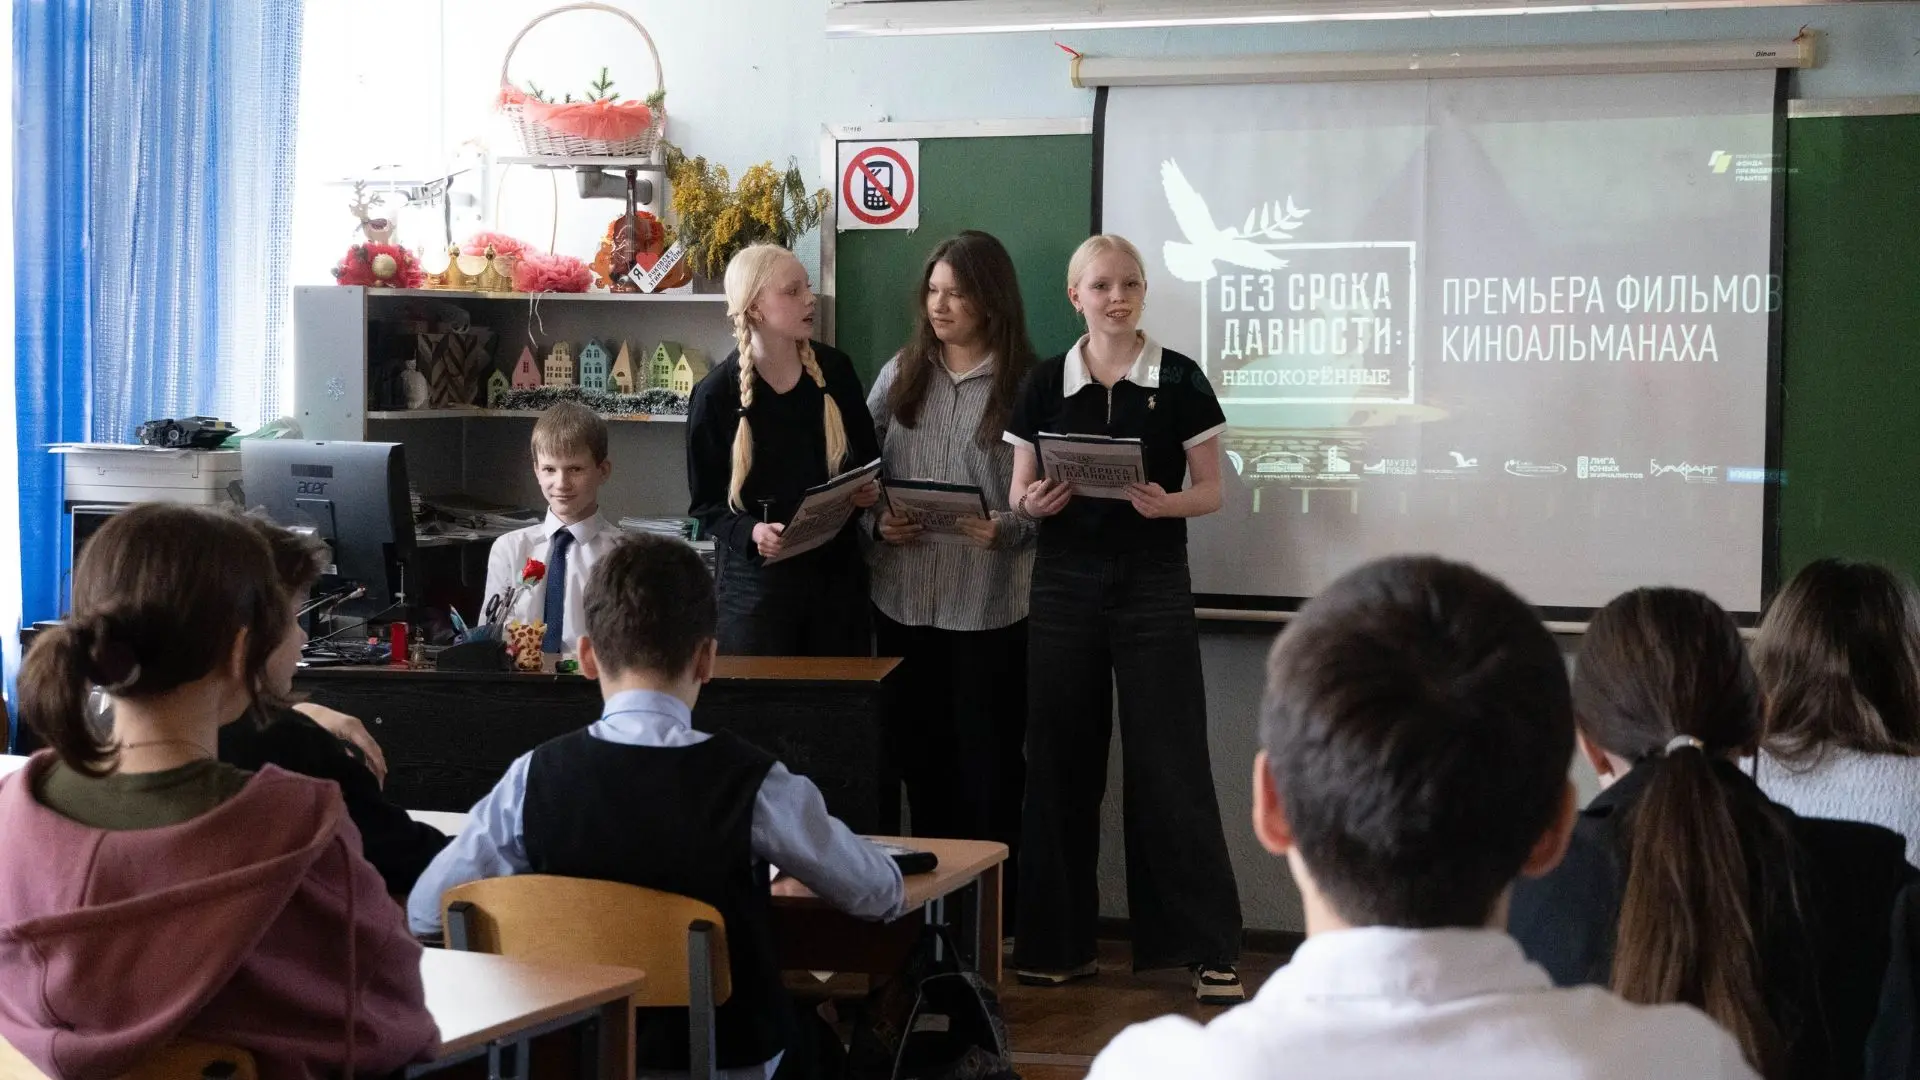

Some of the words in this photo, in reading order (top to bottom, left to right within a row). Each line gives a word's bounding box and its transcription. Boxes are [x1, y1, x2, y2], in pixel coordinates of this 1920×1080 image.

[633, 267, 643, 280] Я
[648, 272, 664, 288] ЭТИМ
[1220, 273, 1275, 312] БЕЗ
[1288, 271, 1392, 311] СРОКА
[1443, 275, 1605, 315] ПРЕМЬЕРА
[1616, 274, 1782, 314] ФИЛЬМОВ
[1221, 317, 1402, 360] ДАВНОСТИ:
[1442, 324, 1719, 362] КИНОАЛЬМАНАХА
[1222, 366, 1391, 386] НЕПОКОРЁННЫЕ
[1591, 457, 1615, 465] ЛИГА
[297, 481, 328, 495] acer
